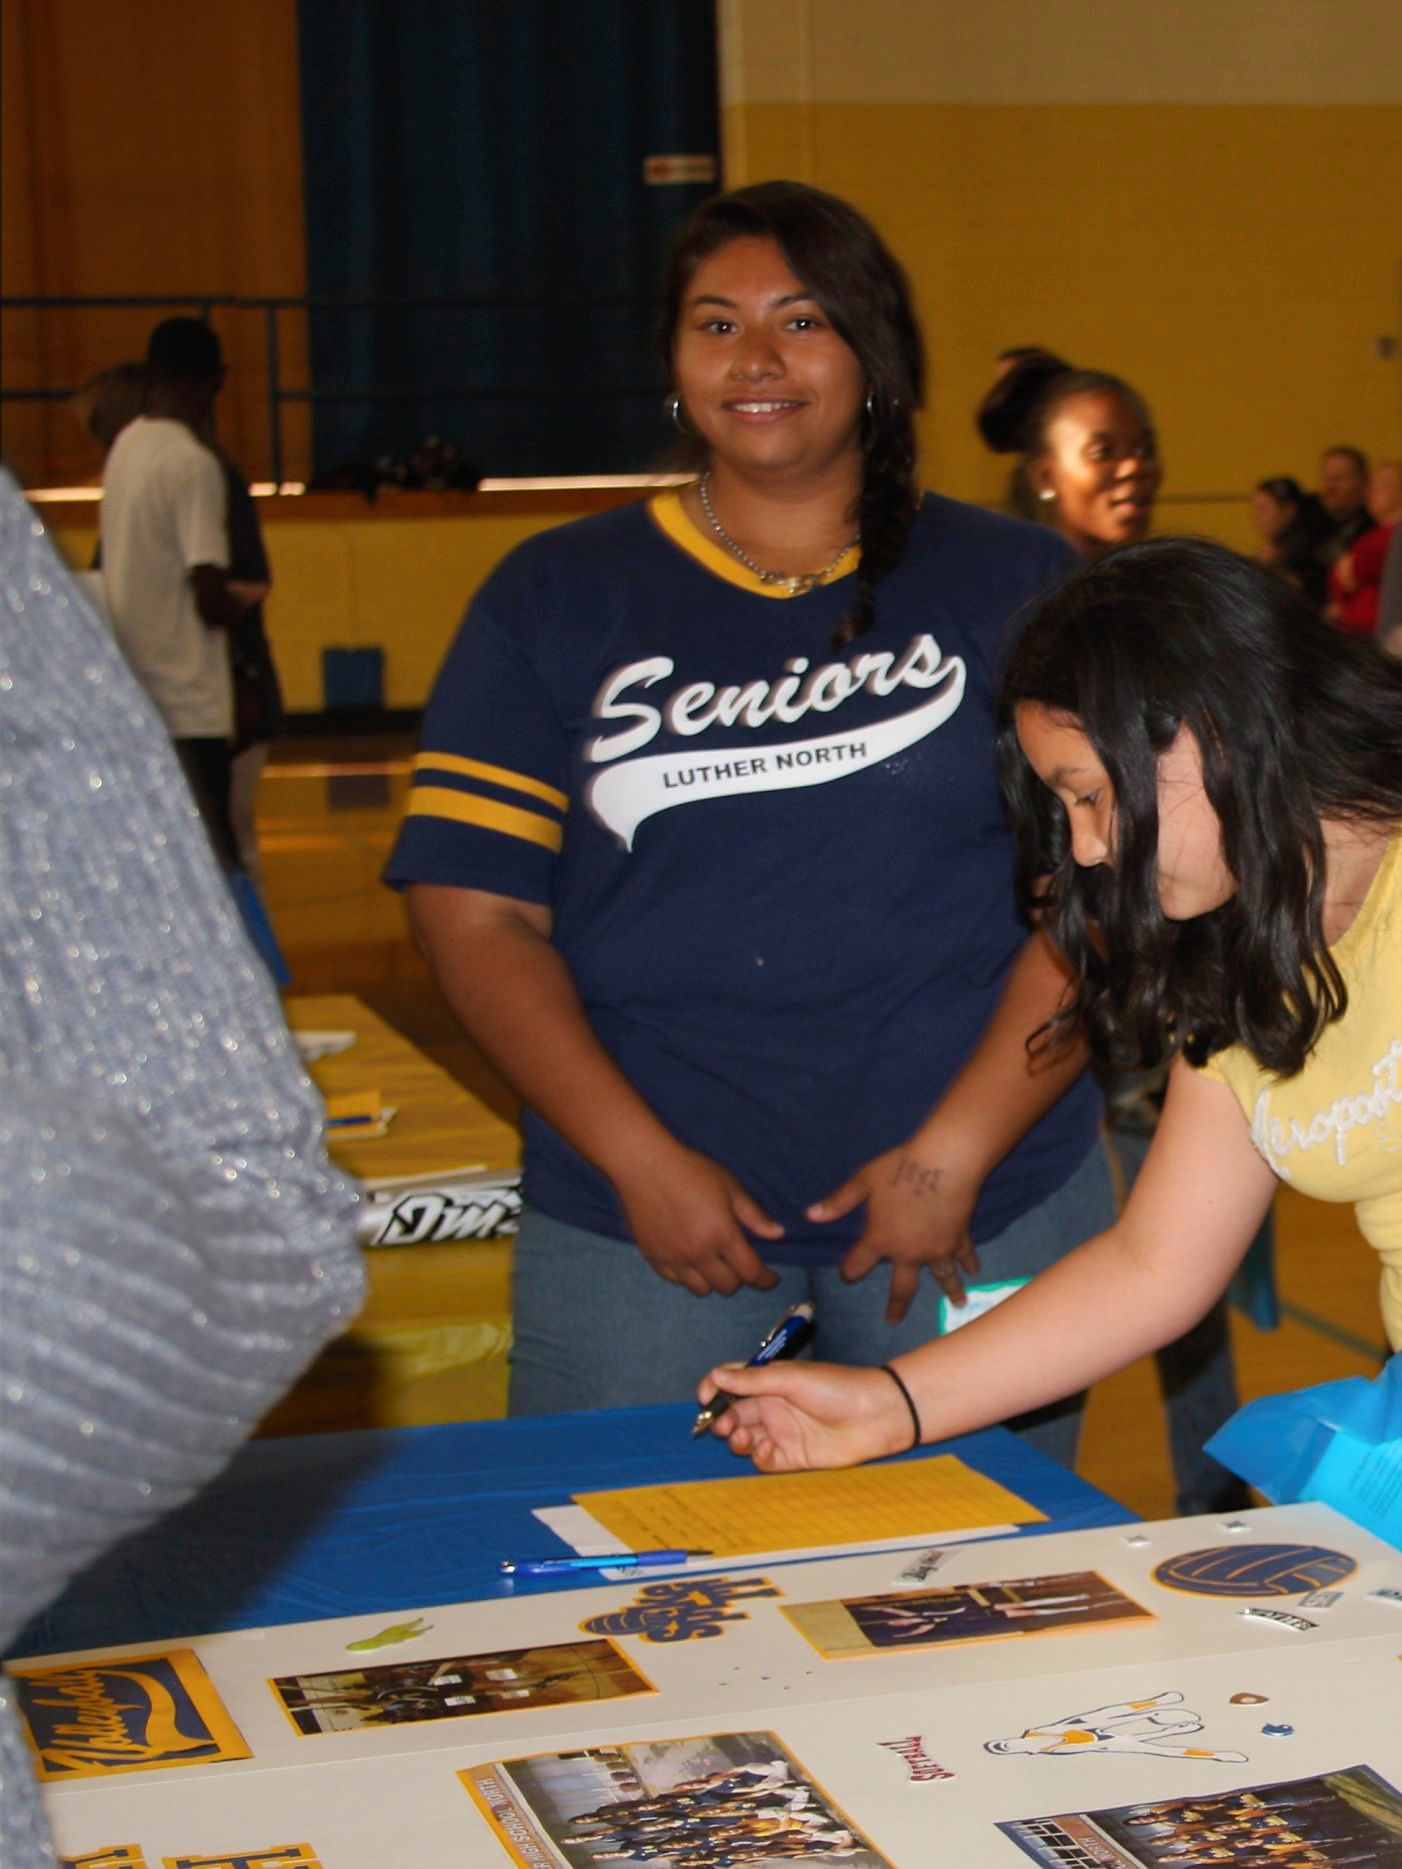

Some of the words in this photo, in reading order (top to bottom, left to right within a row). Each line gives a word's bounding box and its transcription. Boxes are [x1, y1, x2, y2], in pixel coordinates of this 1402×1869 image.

[586, 633, 962, 763] Seniors
[662, 757, 767, 790] LUTHER
[775, 741, 868, 771] NORTH
[875, 1735, 955, 1782] SOFTBALL
